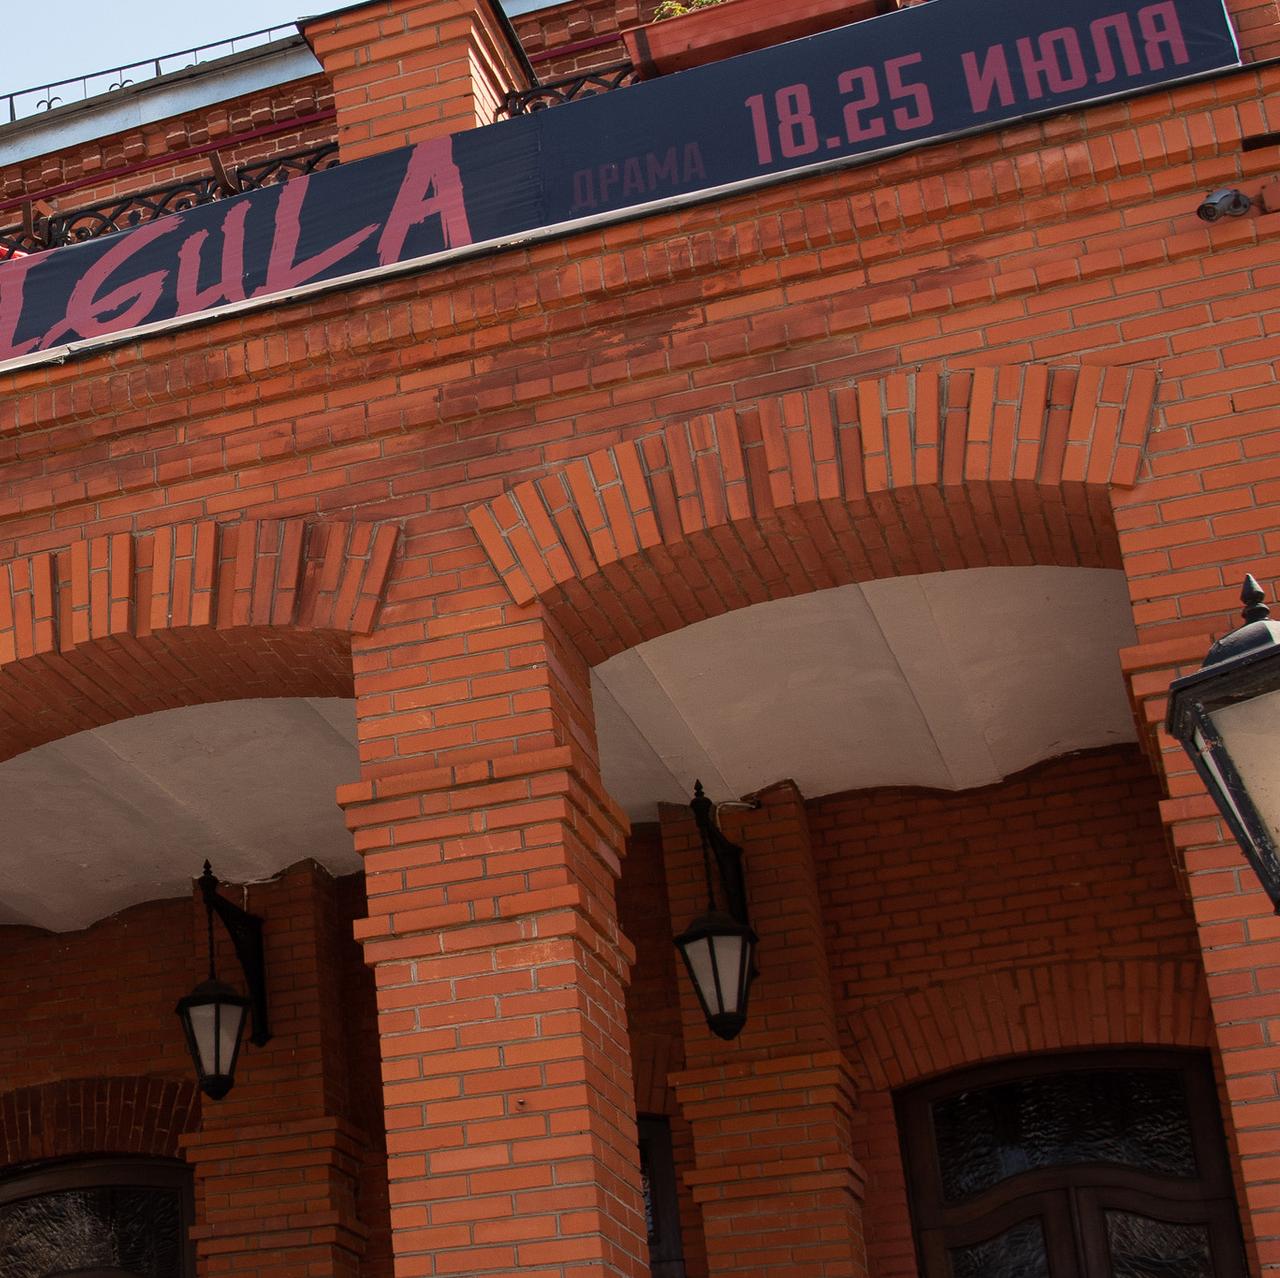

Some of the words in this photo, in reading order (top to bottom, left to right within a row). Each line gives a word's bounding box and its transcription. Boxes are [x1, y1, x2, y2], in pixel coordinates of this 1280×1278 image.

[745, 53, 934, 165] 18.25
[962, 0, 1191, 113] ИЮЛЯ
[571, 142, 707, 213] ДРАМА
